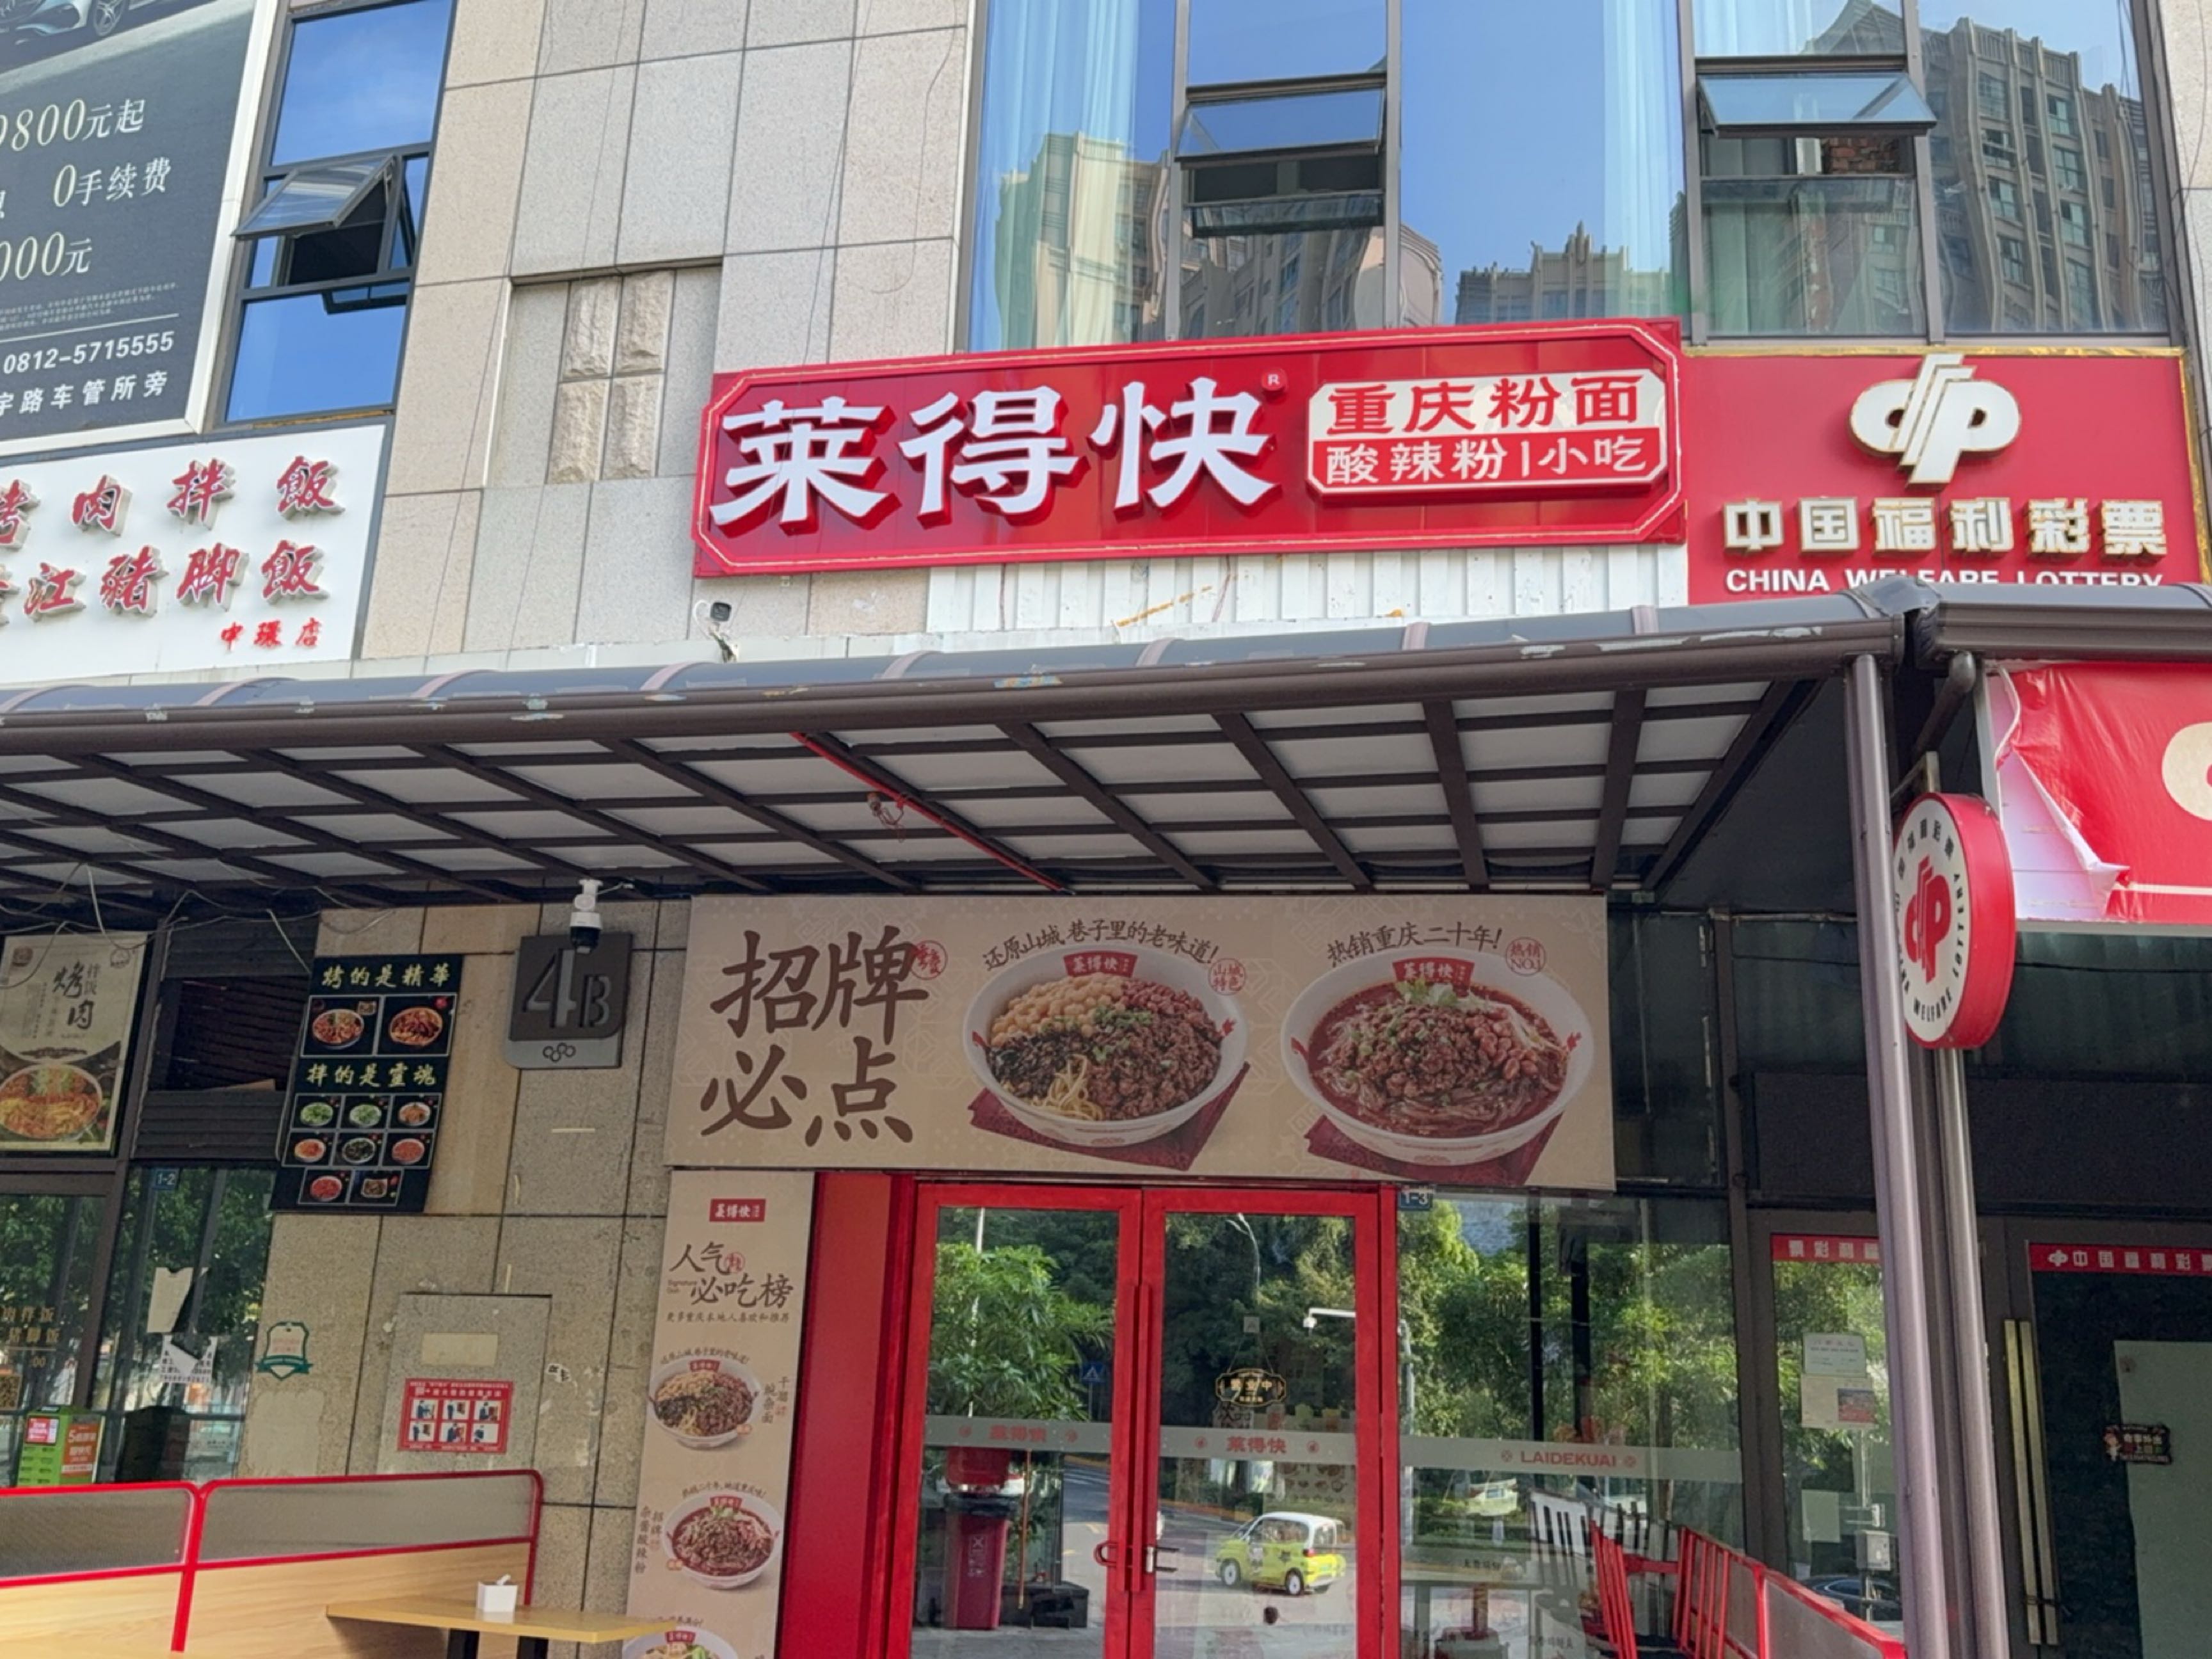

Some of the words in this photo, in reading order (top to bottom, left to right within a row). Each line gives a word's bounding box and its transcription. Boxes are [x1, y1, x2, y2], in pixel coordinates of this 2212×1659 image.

[3, 330, 175, 374] 0812-5715555
[1327, 375, 1644, 435] 重庆粉面
[709, 376, 1279, 525] 莱得快
[1722, 497, 2167, 557] 中国福利彩票
[1726, 569, 1830, 592] CHINA
[710, 924, 930, 1045] 招牌
[700, 1036, 914, 1147] 必点
[157, 1173, 177, 1185] 1-2
[669, 1241, 731, 1276] 人气
[691, 1272, 794, 1308] 必吃榜
[1520, 1451, 1617, 1468] LAIDEKUAI
